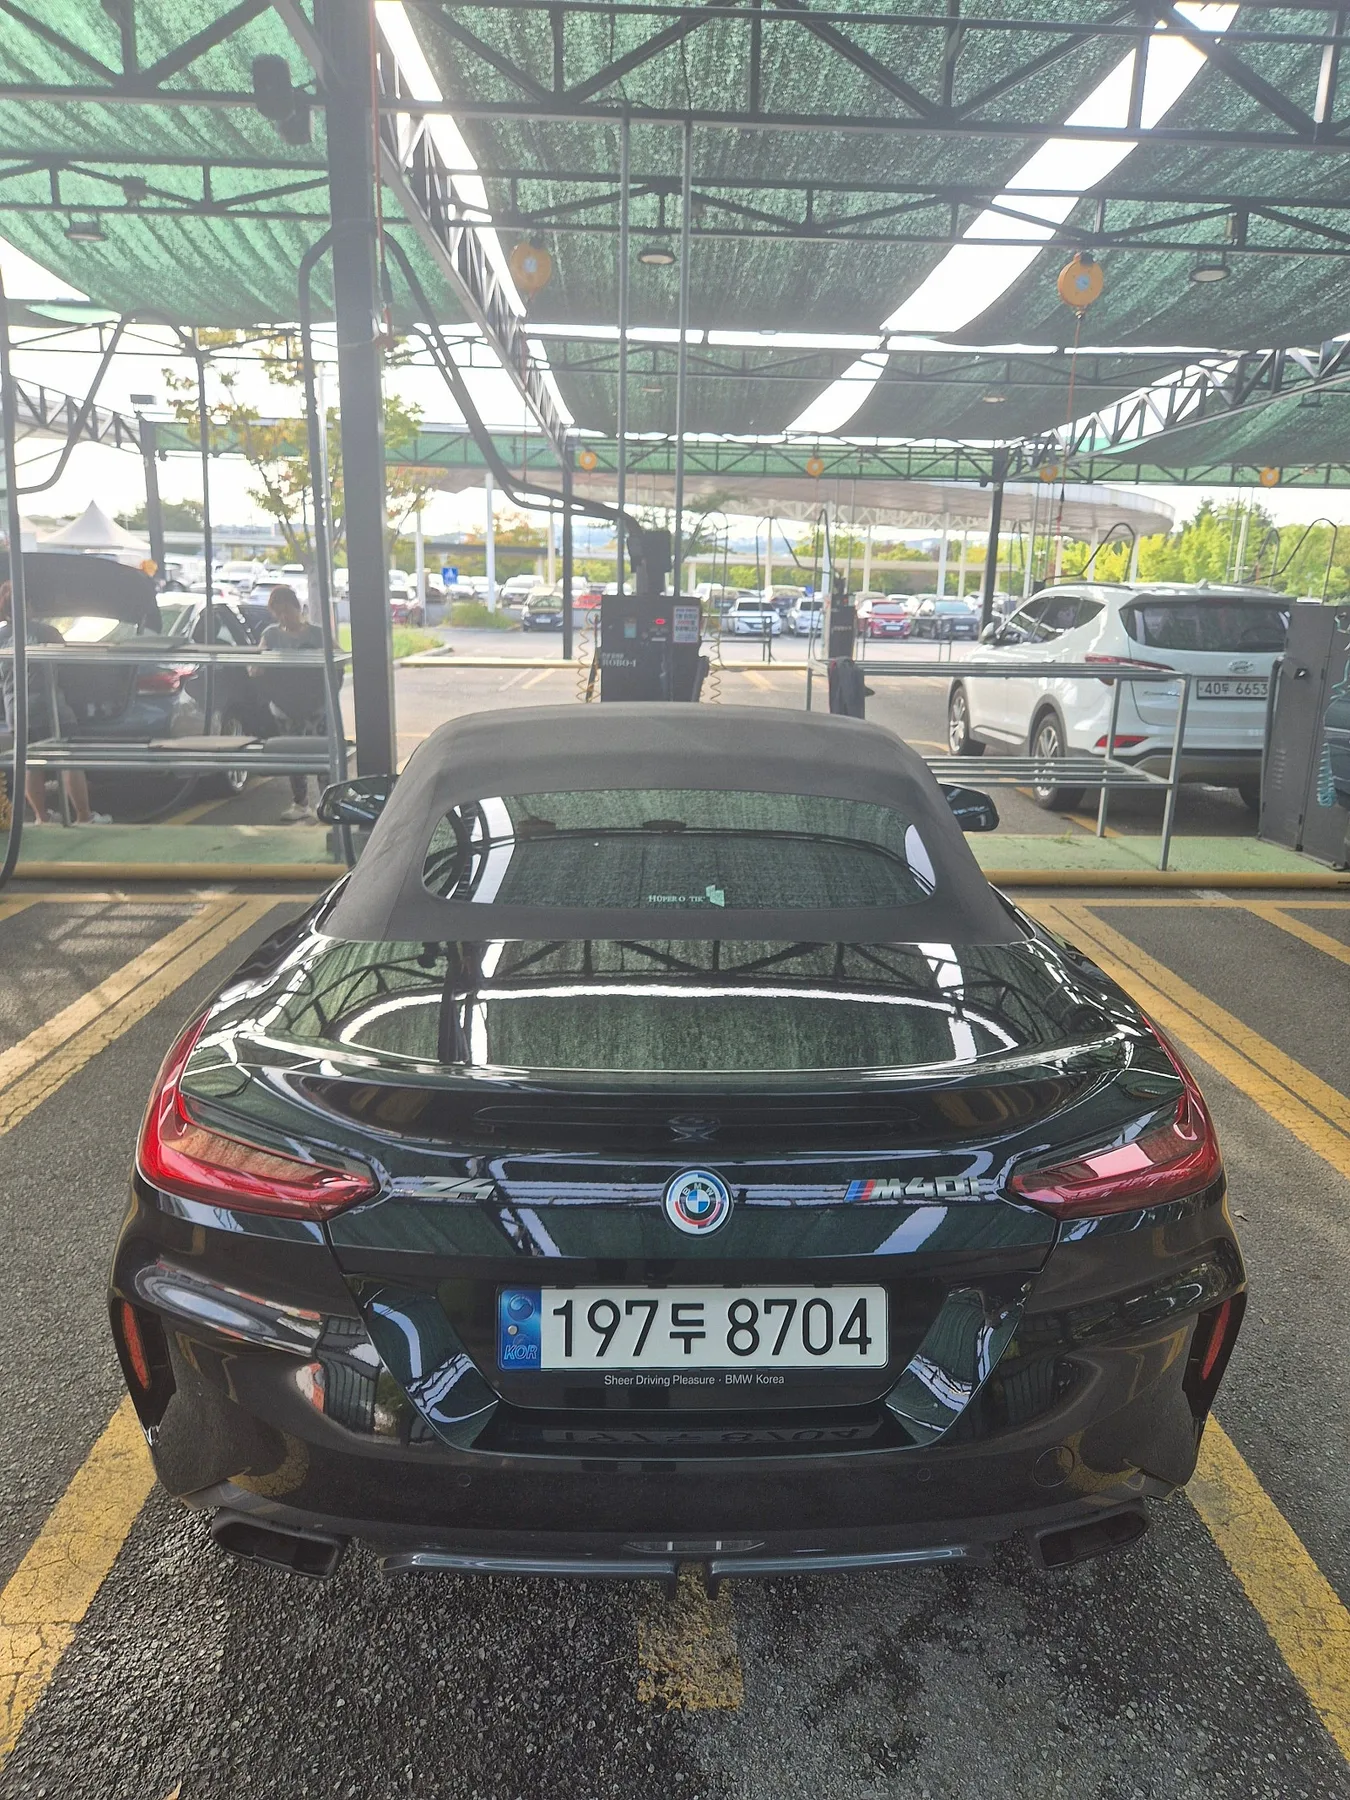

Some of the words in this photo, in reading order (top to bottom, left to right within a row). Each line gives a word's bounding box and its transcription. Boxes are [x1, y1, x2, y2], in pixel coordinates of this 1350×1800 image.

[1236, 682, 1268, 695] 6653
[412, 1176, 495, 1200] Z4
[682, 1182, 715, 1196] BMW
[553, 1298, 706, 1358] 197두
[726, 1298, 873, 1357] 8704
[504, 1344, 538, 1360] KOR
[604, 1374, 634, 1385] Sheer
[636, 1374, 670, 1387] Driving
[672, 1374, 716, 1385] Pleasure
[725, 1374, 753, 1385] BMW
[756, 1374, 785, 1385] Korea
